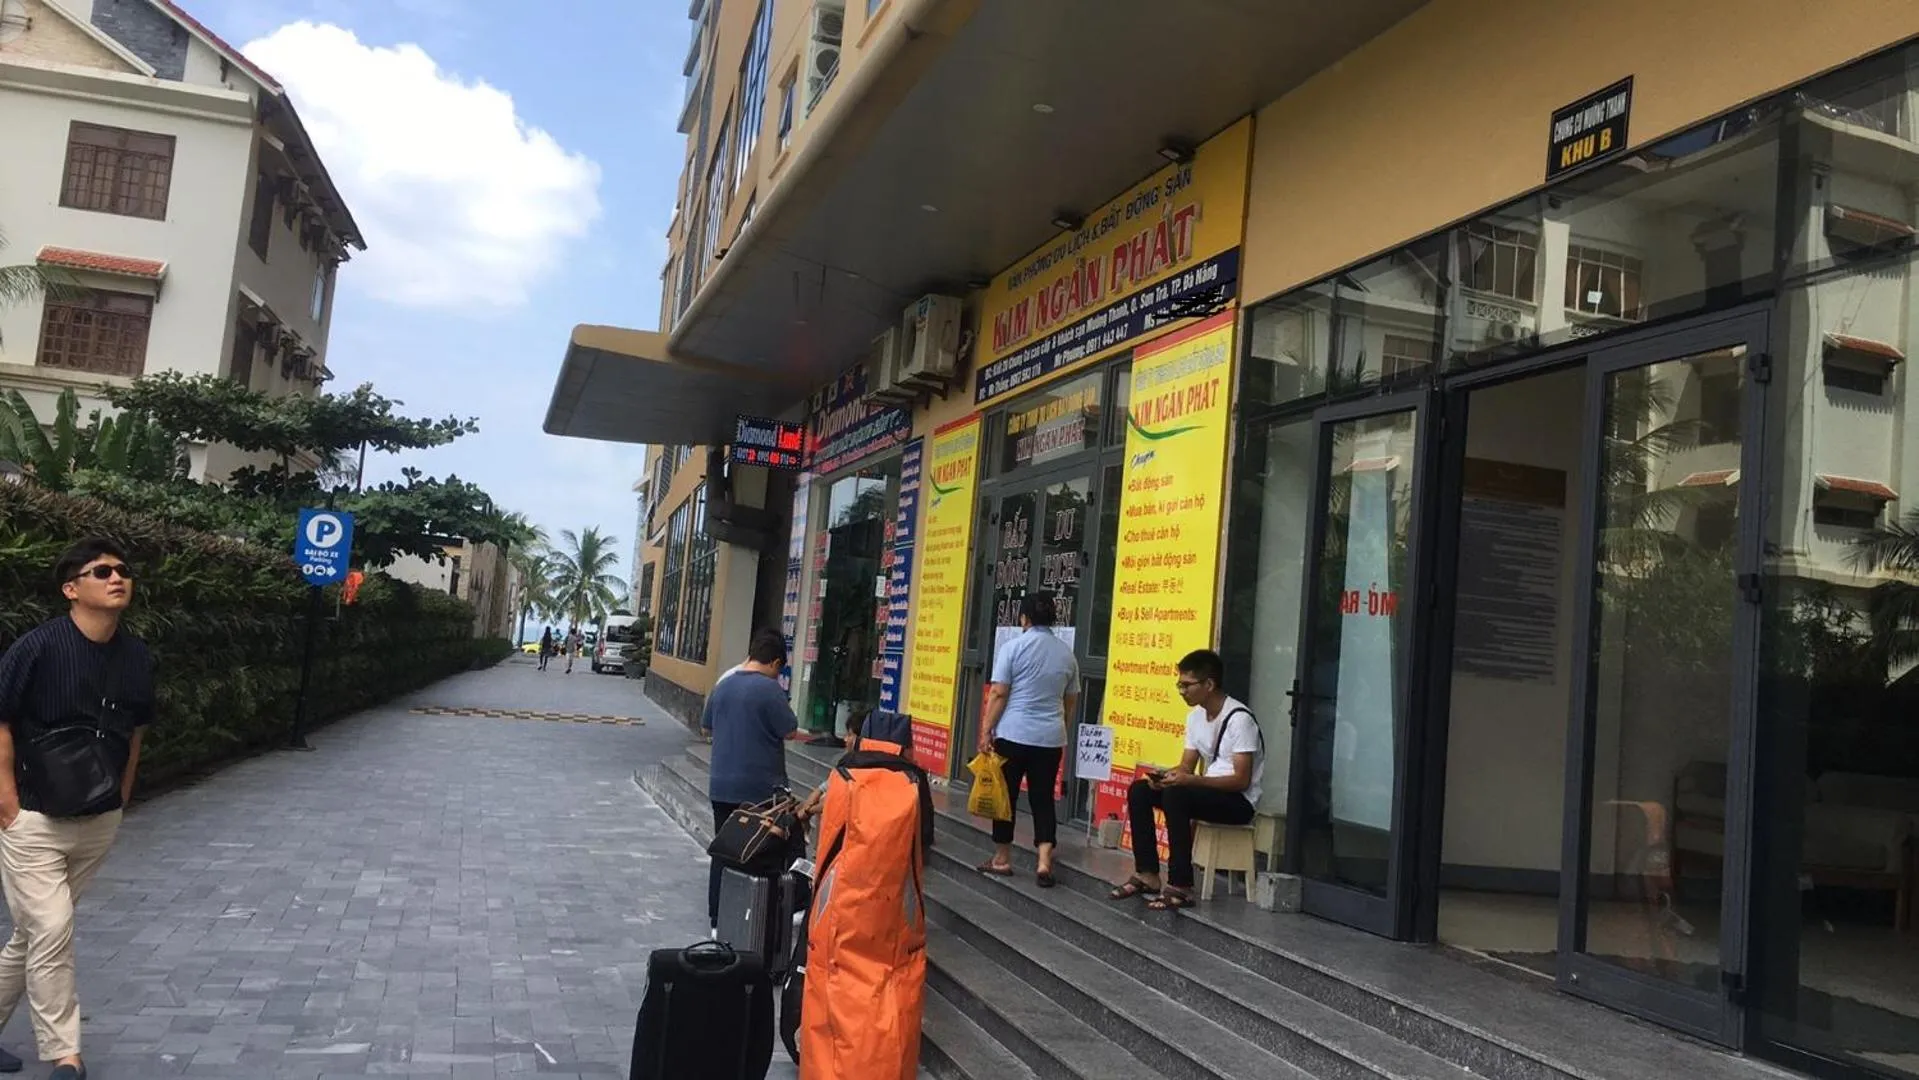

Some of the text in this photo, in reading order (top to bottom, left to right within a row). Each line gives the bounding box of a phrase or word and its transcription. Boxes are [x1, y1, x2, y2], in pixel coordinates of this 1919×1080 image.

[1561, 127, 1612, 167] KHU B
[1053, 242, 1068, 266] DU
[1067, 228, 1090, 257] LỊCH
[1092, 222, 1101, 241] &
[1100, 203, 1122, 235] BẤT
[1125, 184, 1163, 221] ĐỘNG
[1165, 162, 1192, 197] SẢN
[993, 294, 1031, 353] KIM
[1035, 254, 1108, 329] NGÂN
[1110, 202, 1201, 293] PHÁT
[1057, 327, 1075, 346] khách
[1075, 323, 1087, 341] sạn
[1140, 292, 1155, 309] Sơn
[1183, 271, 1195, 291] Đà
[1195, 262, 1219, 287] Nẵng
[1134, 400, 1153, 428] KIM
[1186, 371, 1220, 415] PHÁT
[737, 418, 778, 448] Diamond
[1143, 476, 1160, 491] động
[1194, 493, 1205, 511] hộ
[1003, 505, 1028, 550] BẤT
[1054, 507, 1076, 541] DU
[1127, 529, 1141, 544] Cho
[1156, 524, 1169, 540] căn
[1170, 523, 1181, 541] hộ
[996, 552, 1029, 590] ĐỘNG
[1044, 552, 1077, 591] LỊCH
[1163, 552, 1182, 569] động
[1121, 581, 1137, 594] Real
[1162, 576, 1183, 594] 부동산
[1119, 607, 1134, 623] Buy
[1134, 607, 1139, 620] &
[1140, 607, 1153, 620] Sell
[1115, 659, 1150, 675] Apartment
[1149, 661, 1173, 676] Rental
[1110, 710, 1126, 726] Real
[1126, 713, 1147, 729] Estate
